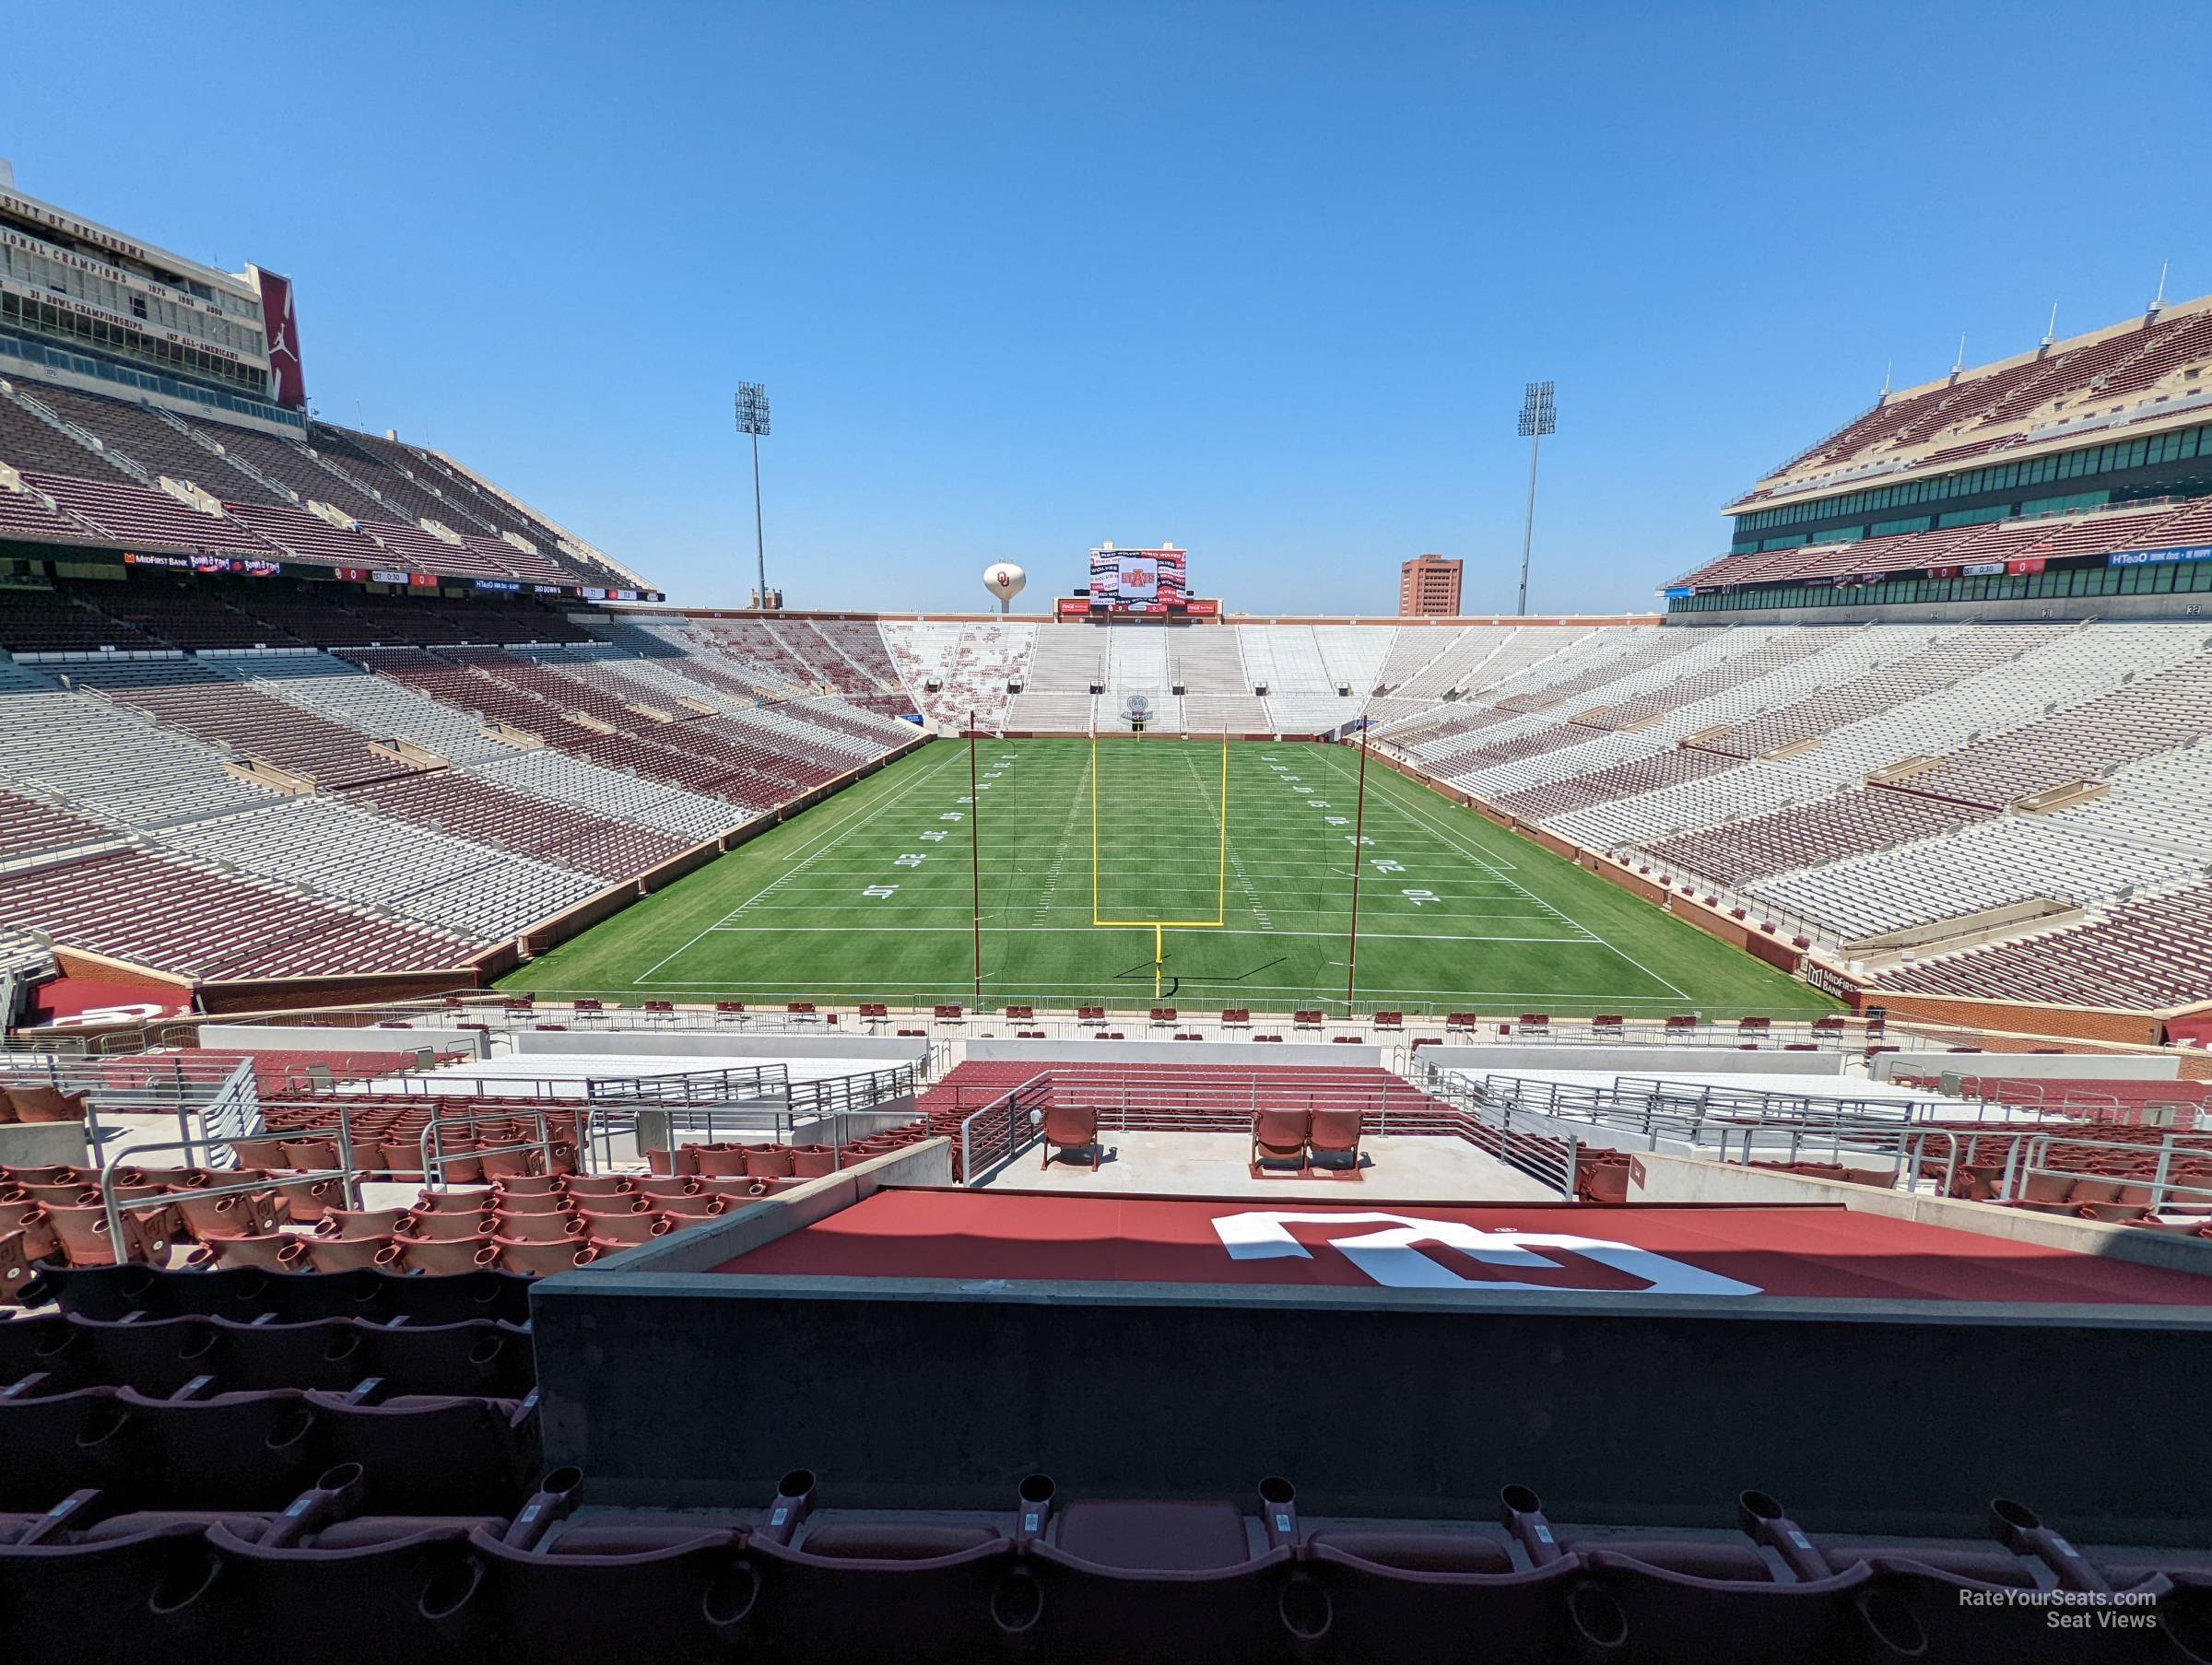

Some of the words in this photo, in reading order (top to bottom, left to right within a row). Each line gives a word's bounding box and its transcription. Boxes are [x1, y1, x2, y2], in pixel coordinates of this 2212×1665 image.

[49, 214, 65, 229] OF
[74, 223, 145, 259] OKLAHOMA
[53, 250, 127, 284] CHAMPIONS
[46, 295, 72, 310] BOWL
[75, 303, 143, 332] CHAMPIONSHIPS
[182, 337, 239, 360] ALL-AMERICANS
[2020, 562, 2026, 571] 0
[2112, 553, 2147, 565] HTeaO
[350, 569, 357, 580] 0
[419, 575, 425, 584] 0
[997, 571, 1009, 587] OU
[1941, 568, 1947, 577] 0
[2187, 605, 2200, 616] 32
[1370, 859, 1406, 873] 20
[1822, 979, 1843, 1000] BANK
